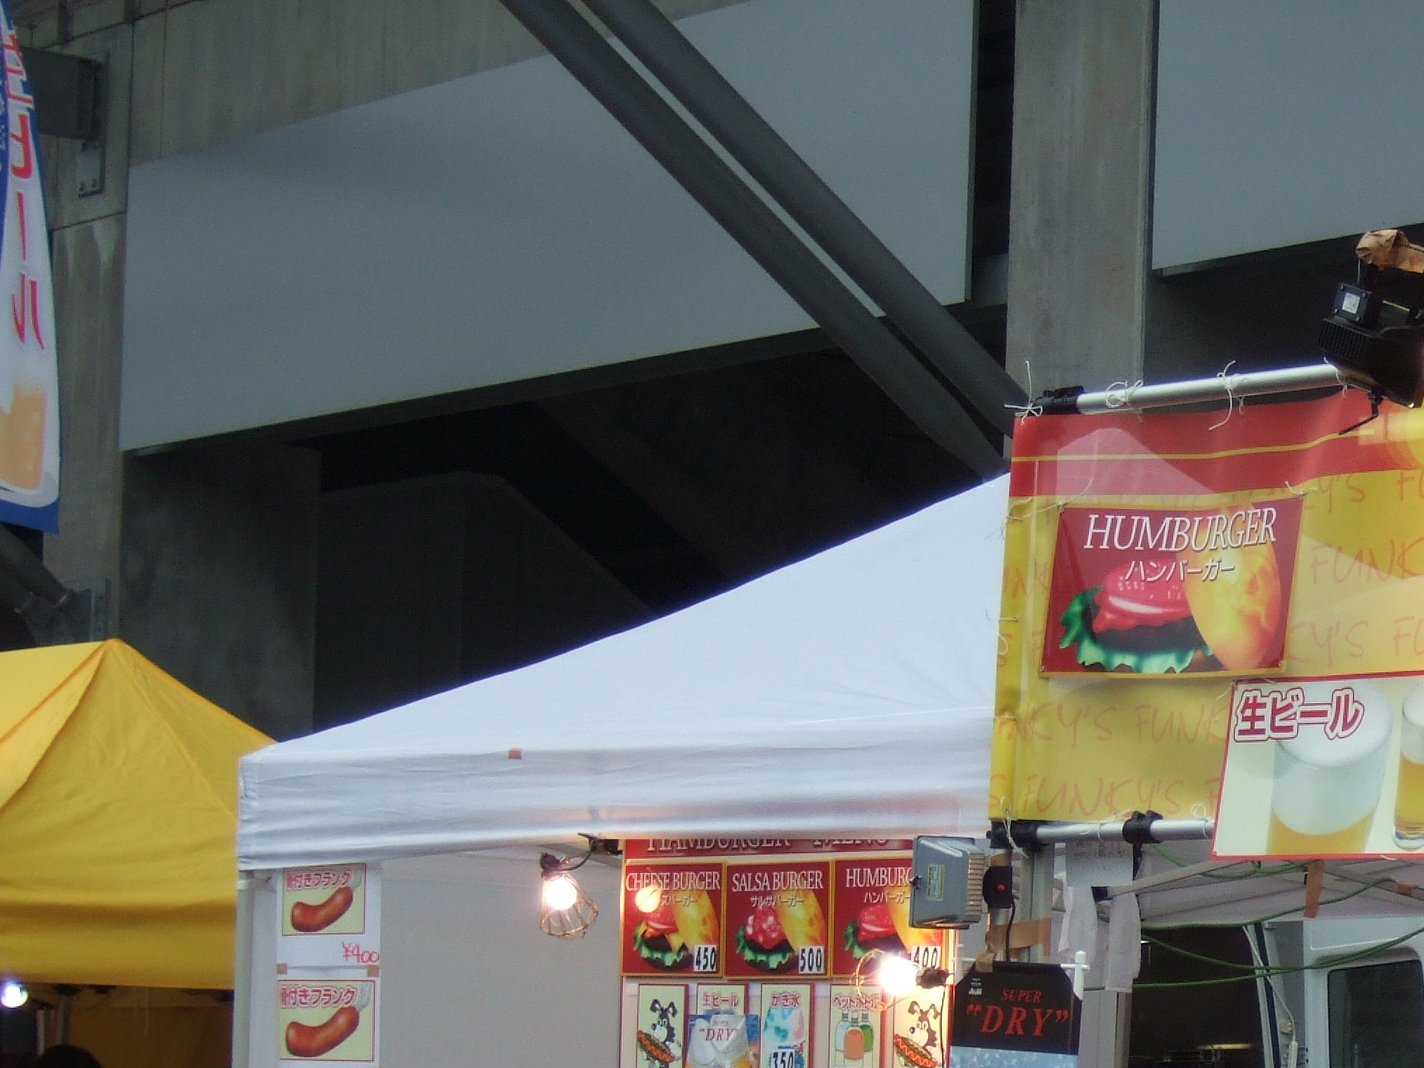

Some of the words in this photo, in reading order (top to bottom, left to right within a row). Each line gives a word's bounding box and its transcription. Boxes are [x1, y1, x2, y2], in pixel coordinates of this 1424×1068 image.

[1084, 507, 1277, 552] HUMBURGER
[1125, 559, 1235, 582] ハンバーガー
[1237, 689, 1363, 740] 生ビール
[672, 871, 721, 891] BURGER
[732, 872, 770, 892] SALSA
[773, 870, 824, 891] BURGER
[695, 946, 717, 971] 450
[800, 947, 823, 972] 500
[913, 946, 938, 968] 400
